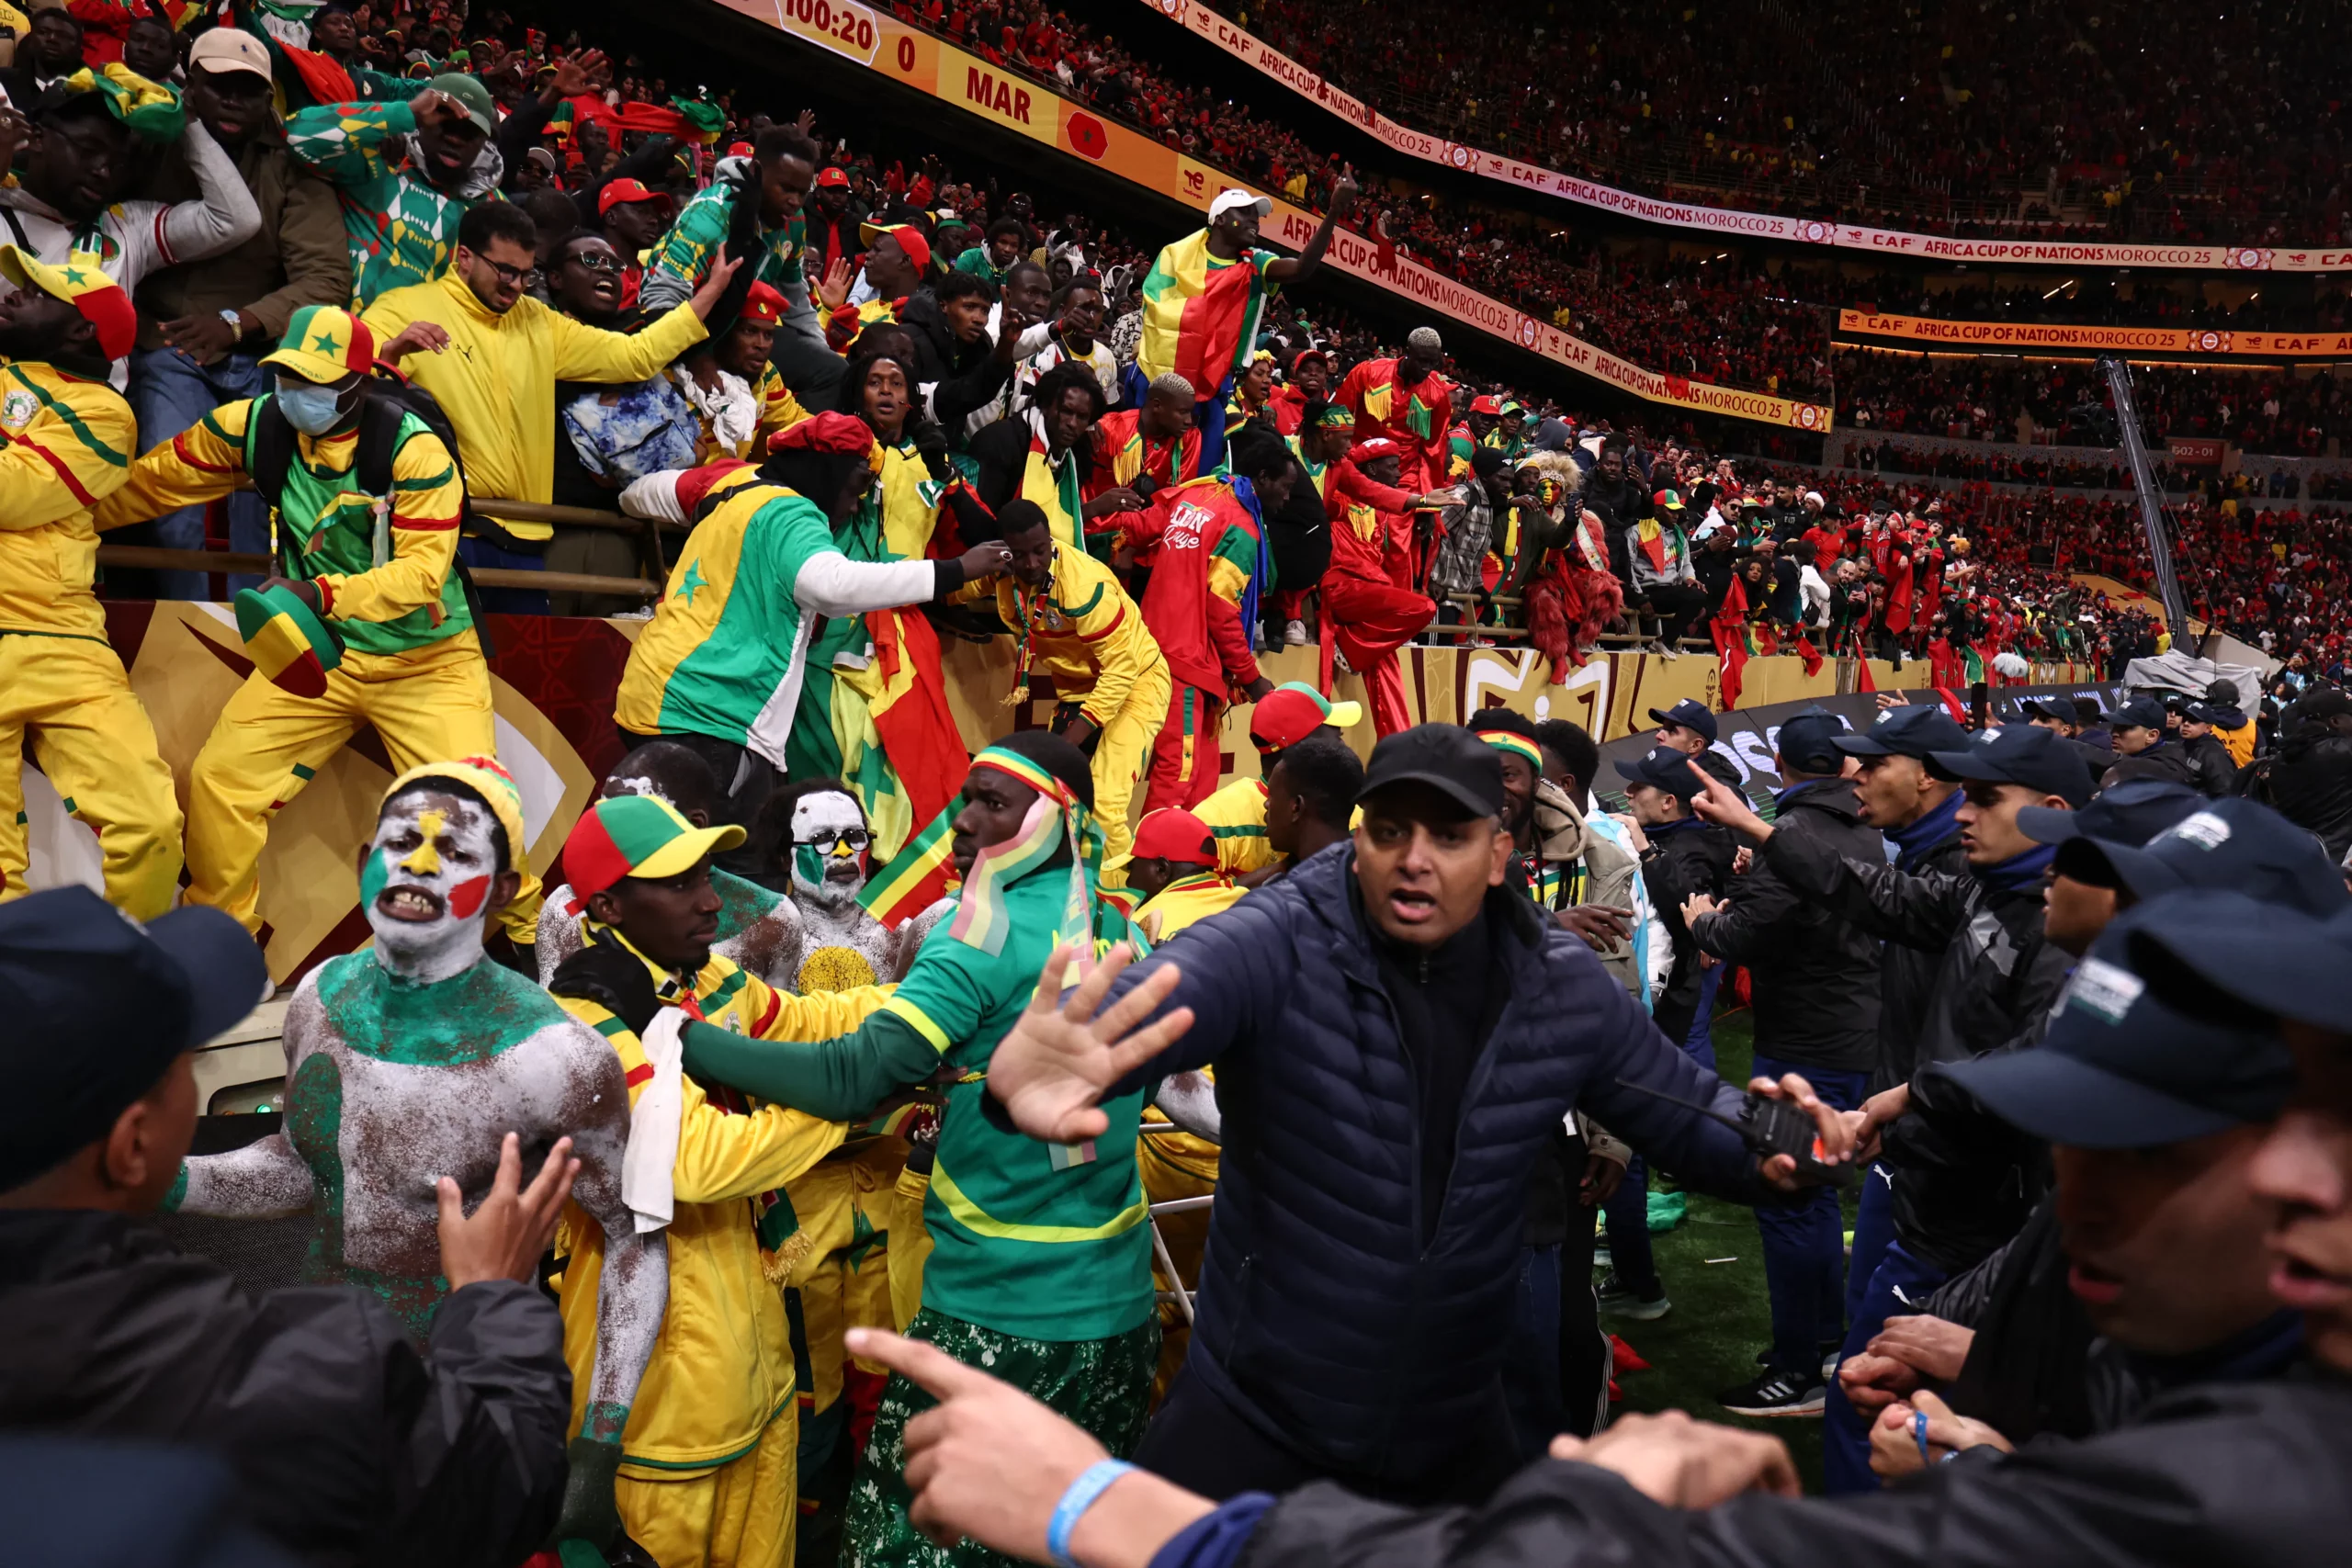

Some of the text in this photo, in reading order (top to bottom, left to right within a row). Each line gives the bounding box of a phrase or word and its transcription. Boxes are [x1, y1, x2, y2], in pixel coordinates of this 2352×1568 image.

[898, 36, 916, 72] 0
[967, 65, 1031, 125] MAR
[1218, 25, 1250, 52] CAF
[1260, 50, 1295, 85] AFRICA
[1296, 72, 1316, 94] CUP
[1368, 119, 1416, 150] OROCCO
[1418, 139, 1432, 154] 25
[1512, 166, 1546, 185] CAF
[1556, 179, 1597, 201] AFRICA
[1599, 190, 1620, 207] CUP
[1622, 197, 1636, 211] OF
[1638, 201, 1692, 222] NATIONS
[1694, 212, 1767, 231] MOROCCO
[1769, 220, 1784, 233] 25
[1872, 234, 1912, 248] CAF
[1924, 240, 1973, 256] AFRICA
[1977, 244, 2008, 257] CUP
[2010, 245, 2032, 258] OF
[2035, 246, 2104, 260] NATIONS
[2106, 249, 2190, 263] MOROCCO
[2193, 251, 2211, 263] 25
[1340, 239, 1366, 268] CUP
[1387, 263, 1441, 302] NATIONS
[1441, 284, 1496, 325] MOROCCO
[1497, 310, 1509, 332] 25
[1868, 318, 1904, 331] CAF
[1915, 322, 1960, 338] AFRICA
[1962, 326, 1991, 339] CUP
[1993, 327, 2013, 340] OF
[2016, 328, 2078, 343] NATIONS
[2080, 331, 2157, 345] MOROCCO
[2159, 333, 2176, 346] 25
[2274, 338, 2320, 350] CAF
[1565, 342, 1589, 365] CAF
[1595, 355, 1621, 382] AFRICA
[1623, 367, 1636, 389] CUP
[1636, 374, 1646, 391] OF
[1702, 389, 1767, 416] MOROCCO
[1769, 402, 1782, 419] 25
